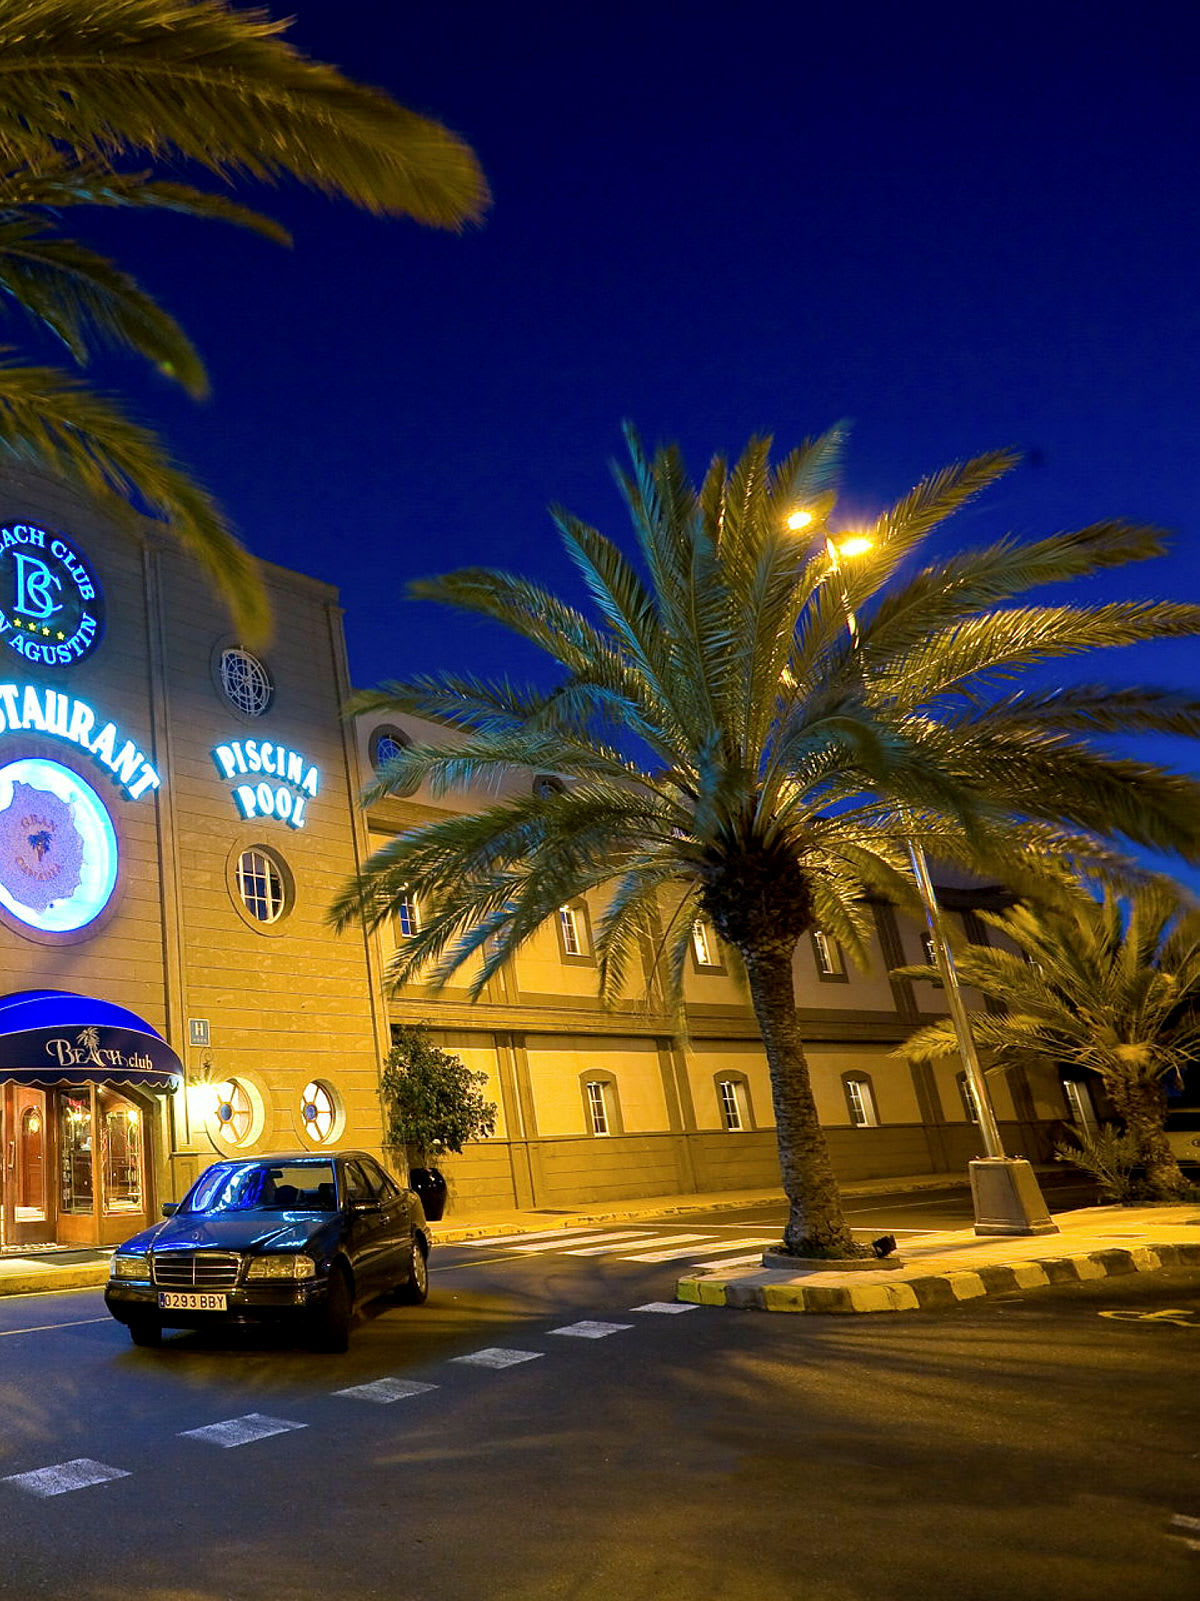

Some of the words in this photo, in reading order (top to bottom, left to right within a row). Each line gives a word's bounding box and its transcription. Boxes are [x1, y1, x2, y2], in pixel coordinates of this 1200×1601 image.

[50, 540, 95, 601] CLUB
[8, 612, 97, 665] AGUSTIN
[215, 739, 318, 797] PISCINA
[236, 782, 305, 829] POOL
[194, 1021, 204, 1037] H
[128, 1052, 153, 1070] club
[165, 1294, 197, 1308] 0293
[200, 1295, 224, 1309] BBY
